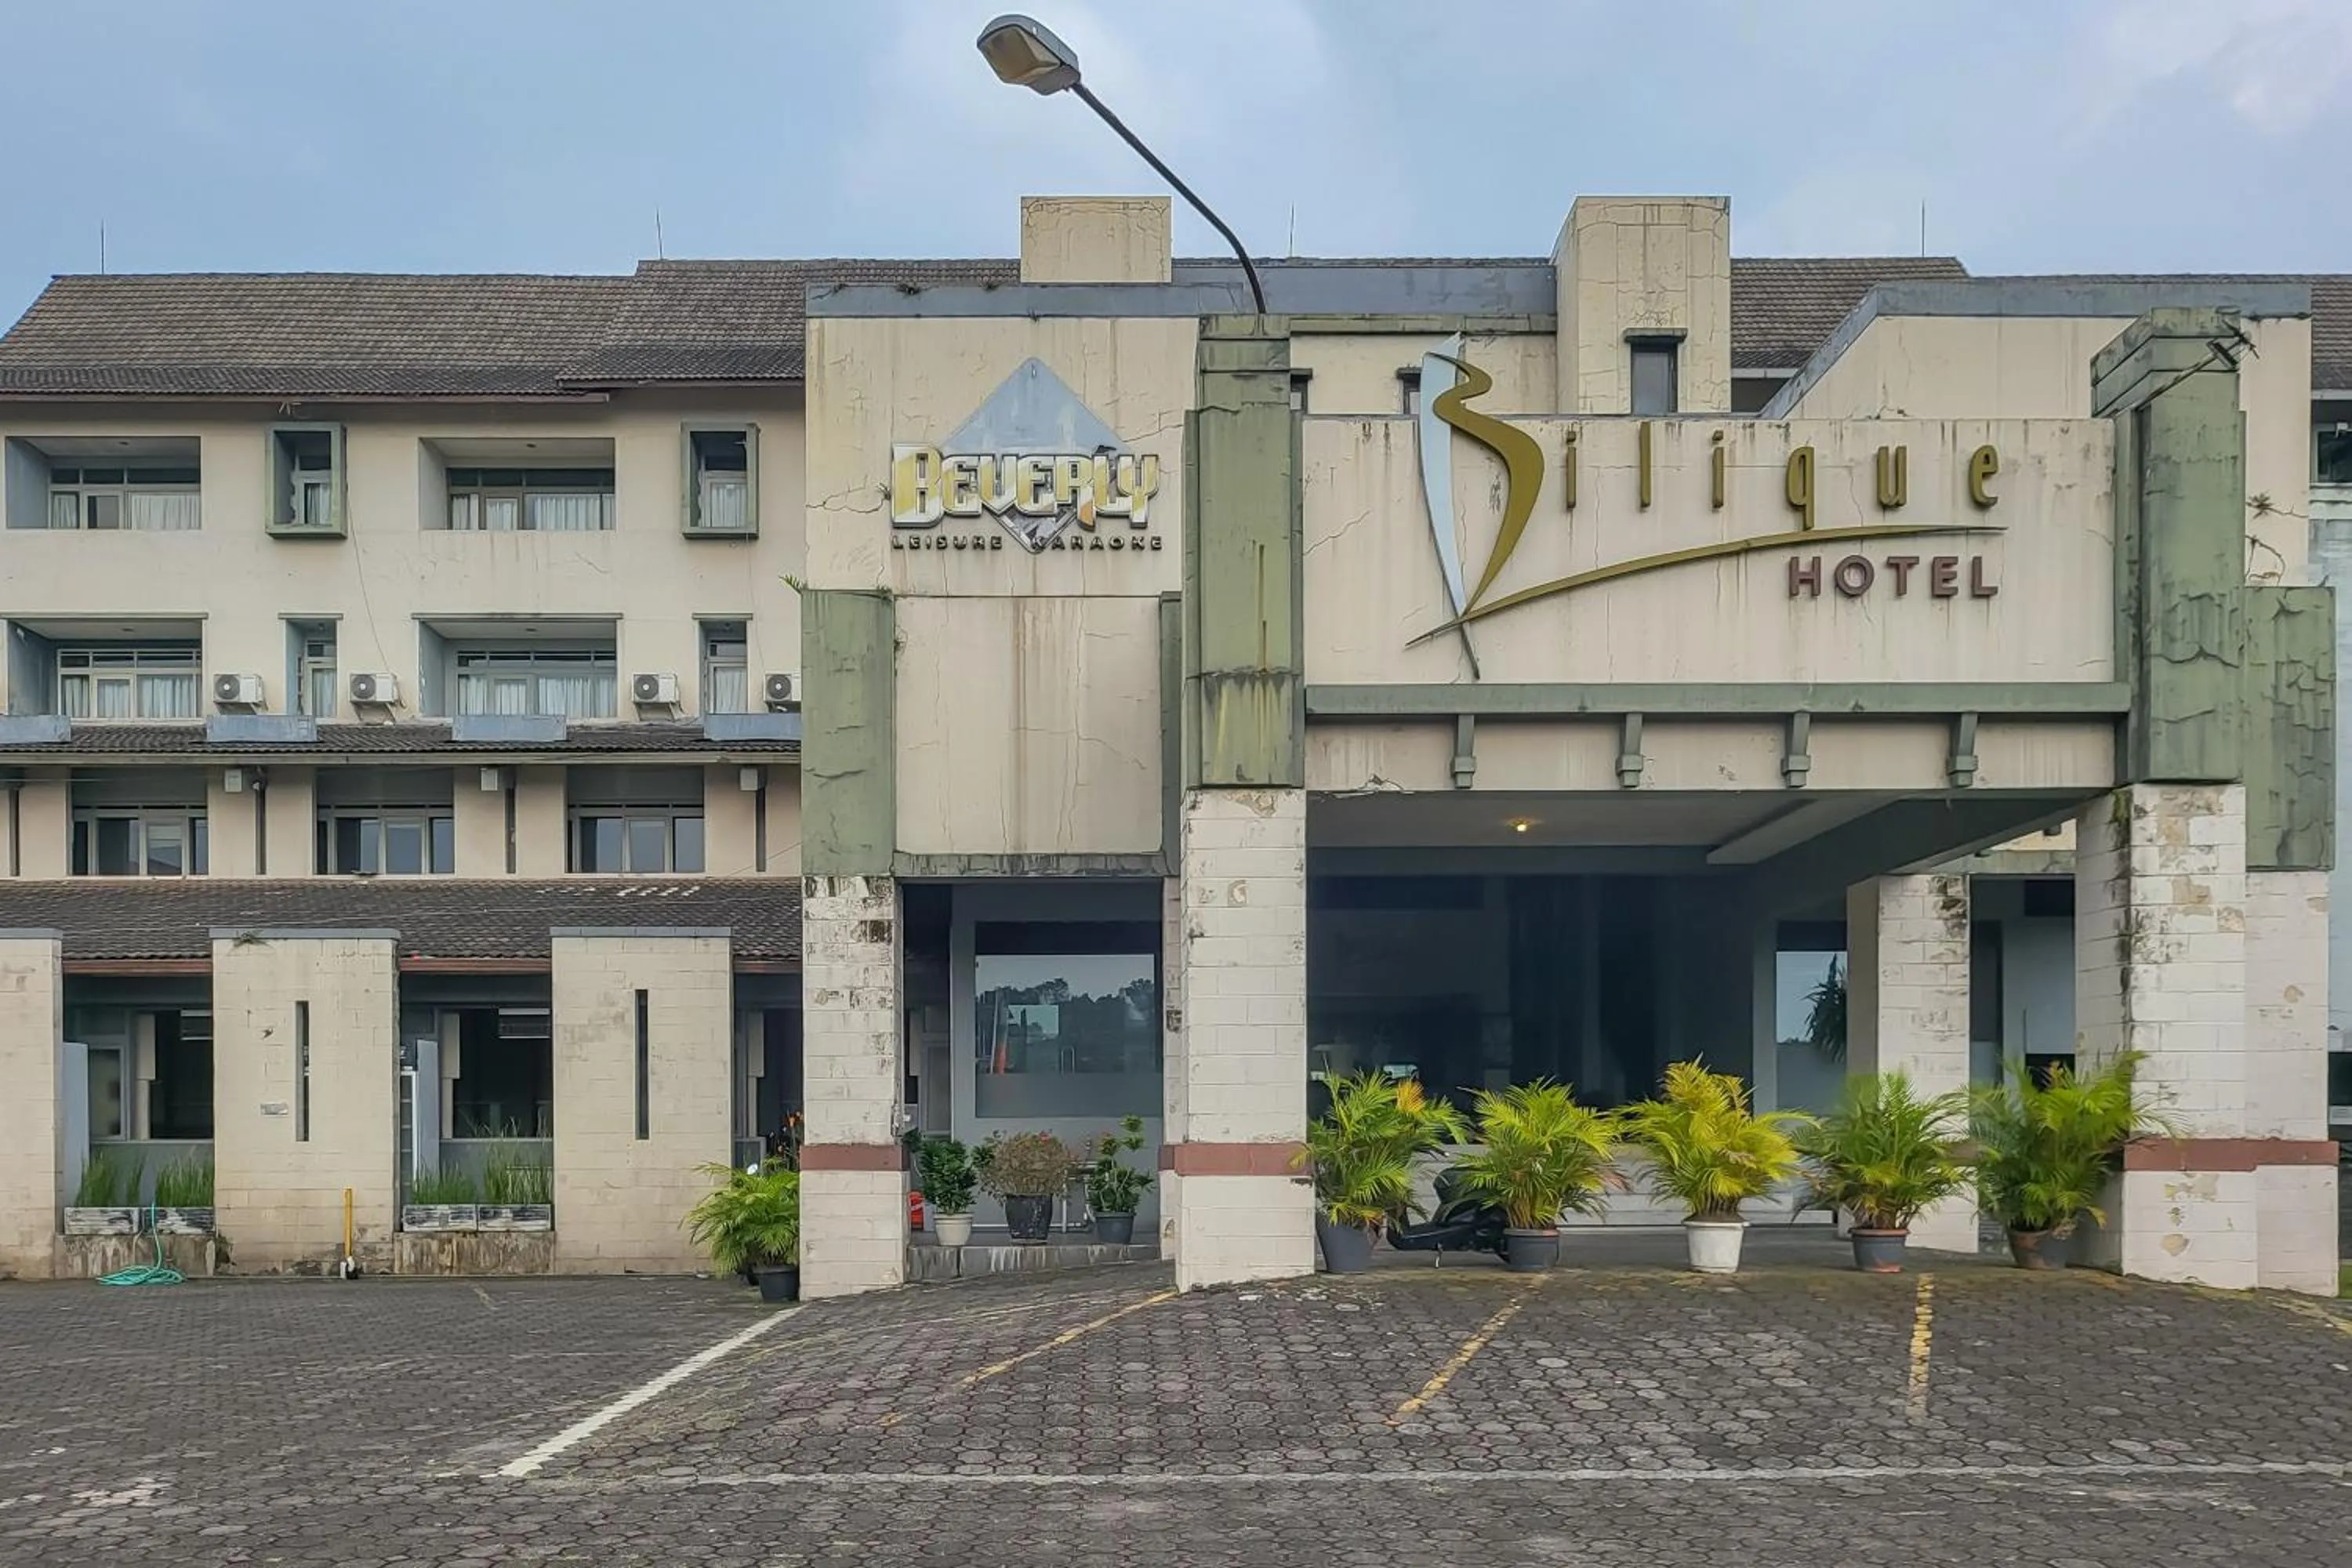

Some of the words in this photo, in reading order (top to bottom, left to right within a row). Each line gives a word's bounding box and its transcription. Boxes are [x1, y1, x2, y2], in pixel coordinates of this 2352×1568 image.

[892, 443, 1160, 532] BEVERLY
[891, 535, 1003, 550] LEISURE
[1030, 535, 1162, 550] KARAOKE
[1789, 554, 1998, 597] HOTEL
